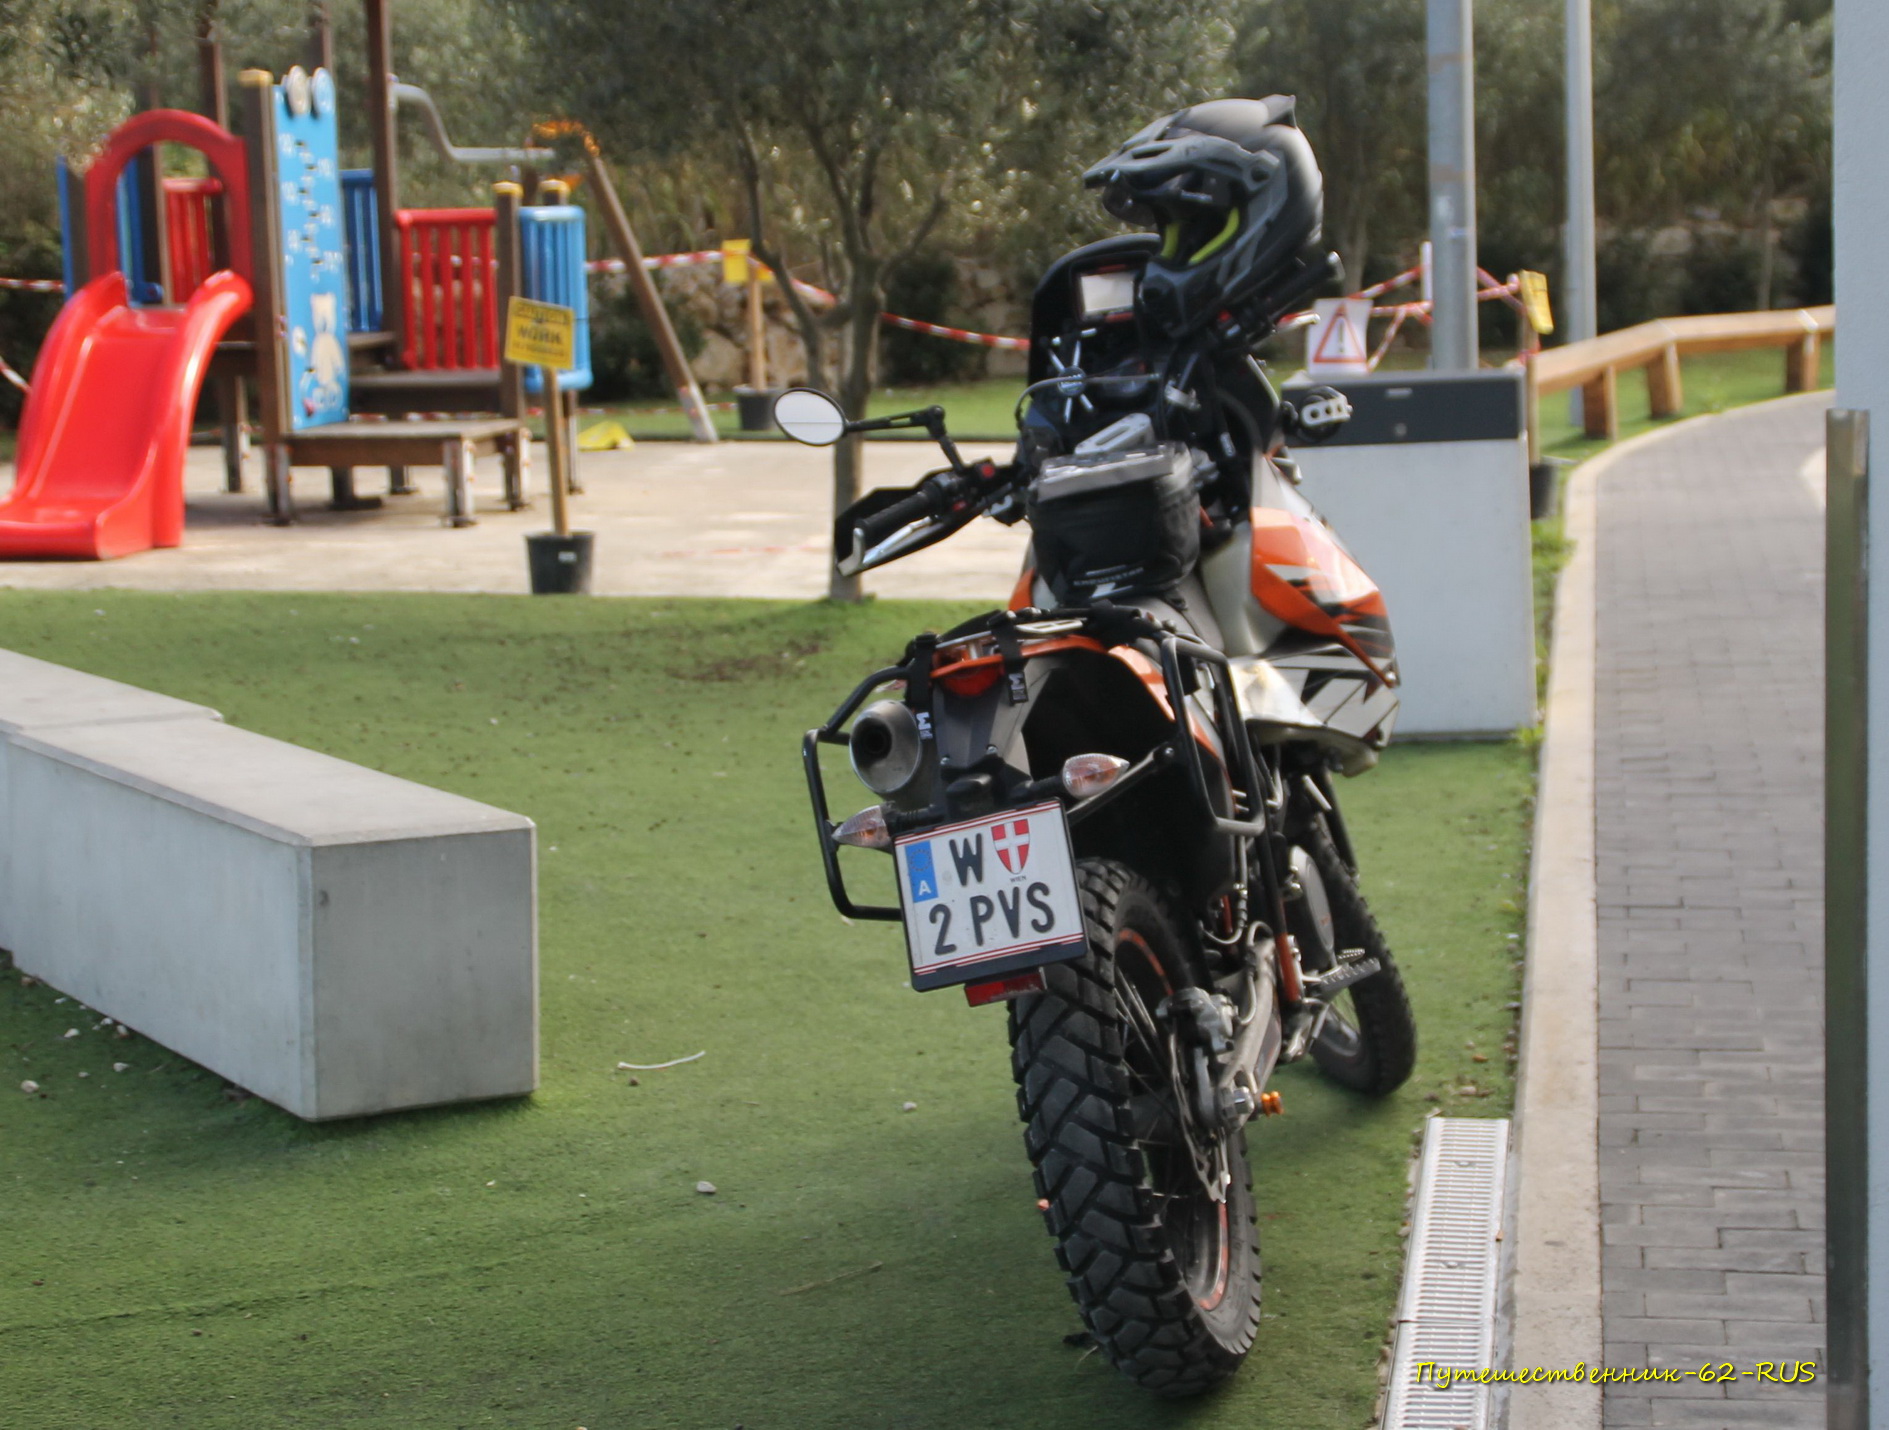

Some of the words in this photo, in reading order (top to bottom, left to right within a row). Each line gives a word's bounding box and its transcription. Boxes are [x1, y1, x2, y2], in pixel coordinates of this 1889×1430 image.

[949, 833, 983, 887] W
[918, 880, 932, 896] A
[928, 903, 957, 956] 2
[969, 881, 1055, 947] PVS
